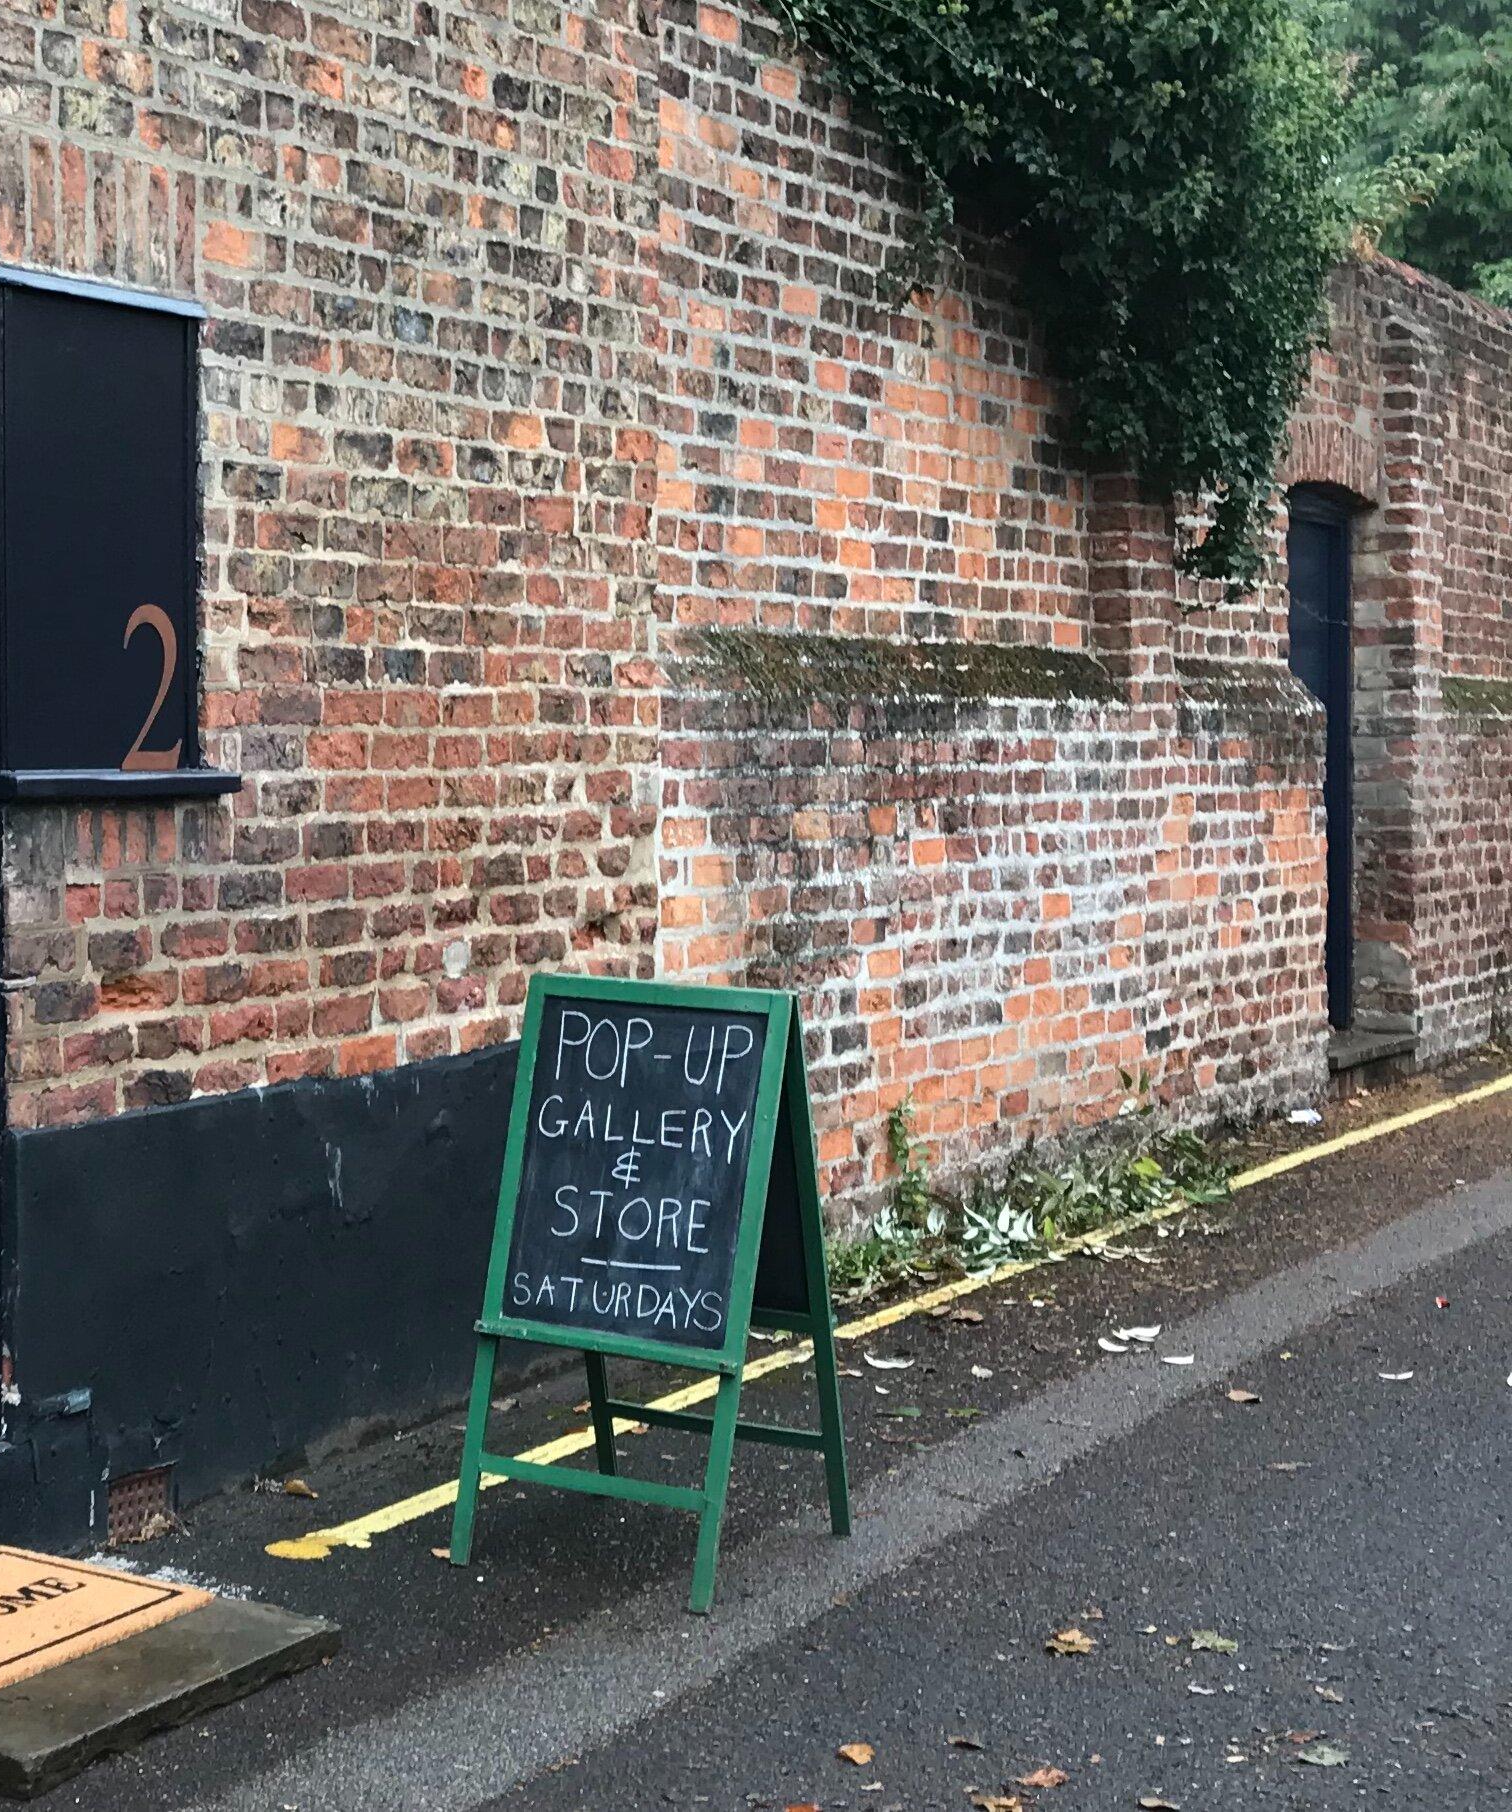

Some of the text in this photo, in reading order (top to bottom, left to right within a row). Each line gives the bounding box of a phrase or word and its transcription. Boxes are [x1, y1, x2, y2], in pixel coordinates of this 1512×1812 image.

[121, 603, 183, 771] 2
[554, 1010, 754, 1094] POP-UP
[538, 1094, 747, 1164] GALLERY
[611, 1146, 641, 1189] &
[550, 1185, 711, 1254] STORE
[513, 1272, 723, 1332] SATURDAYS
